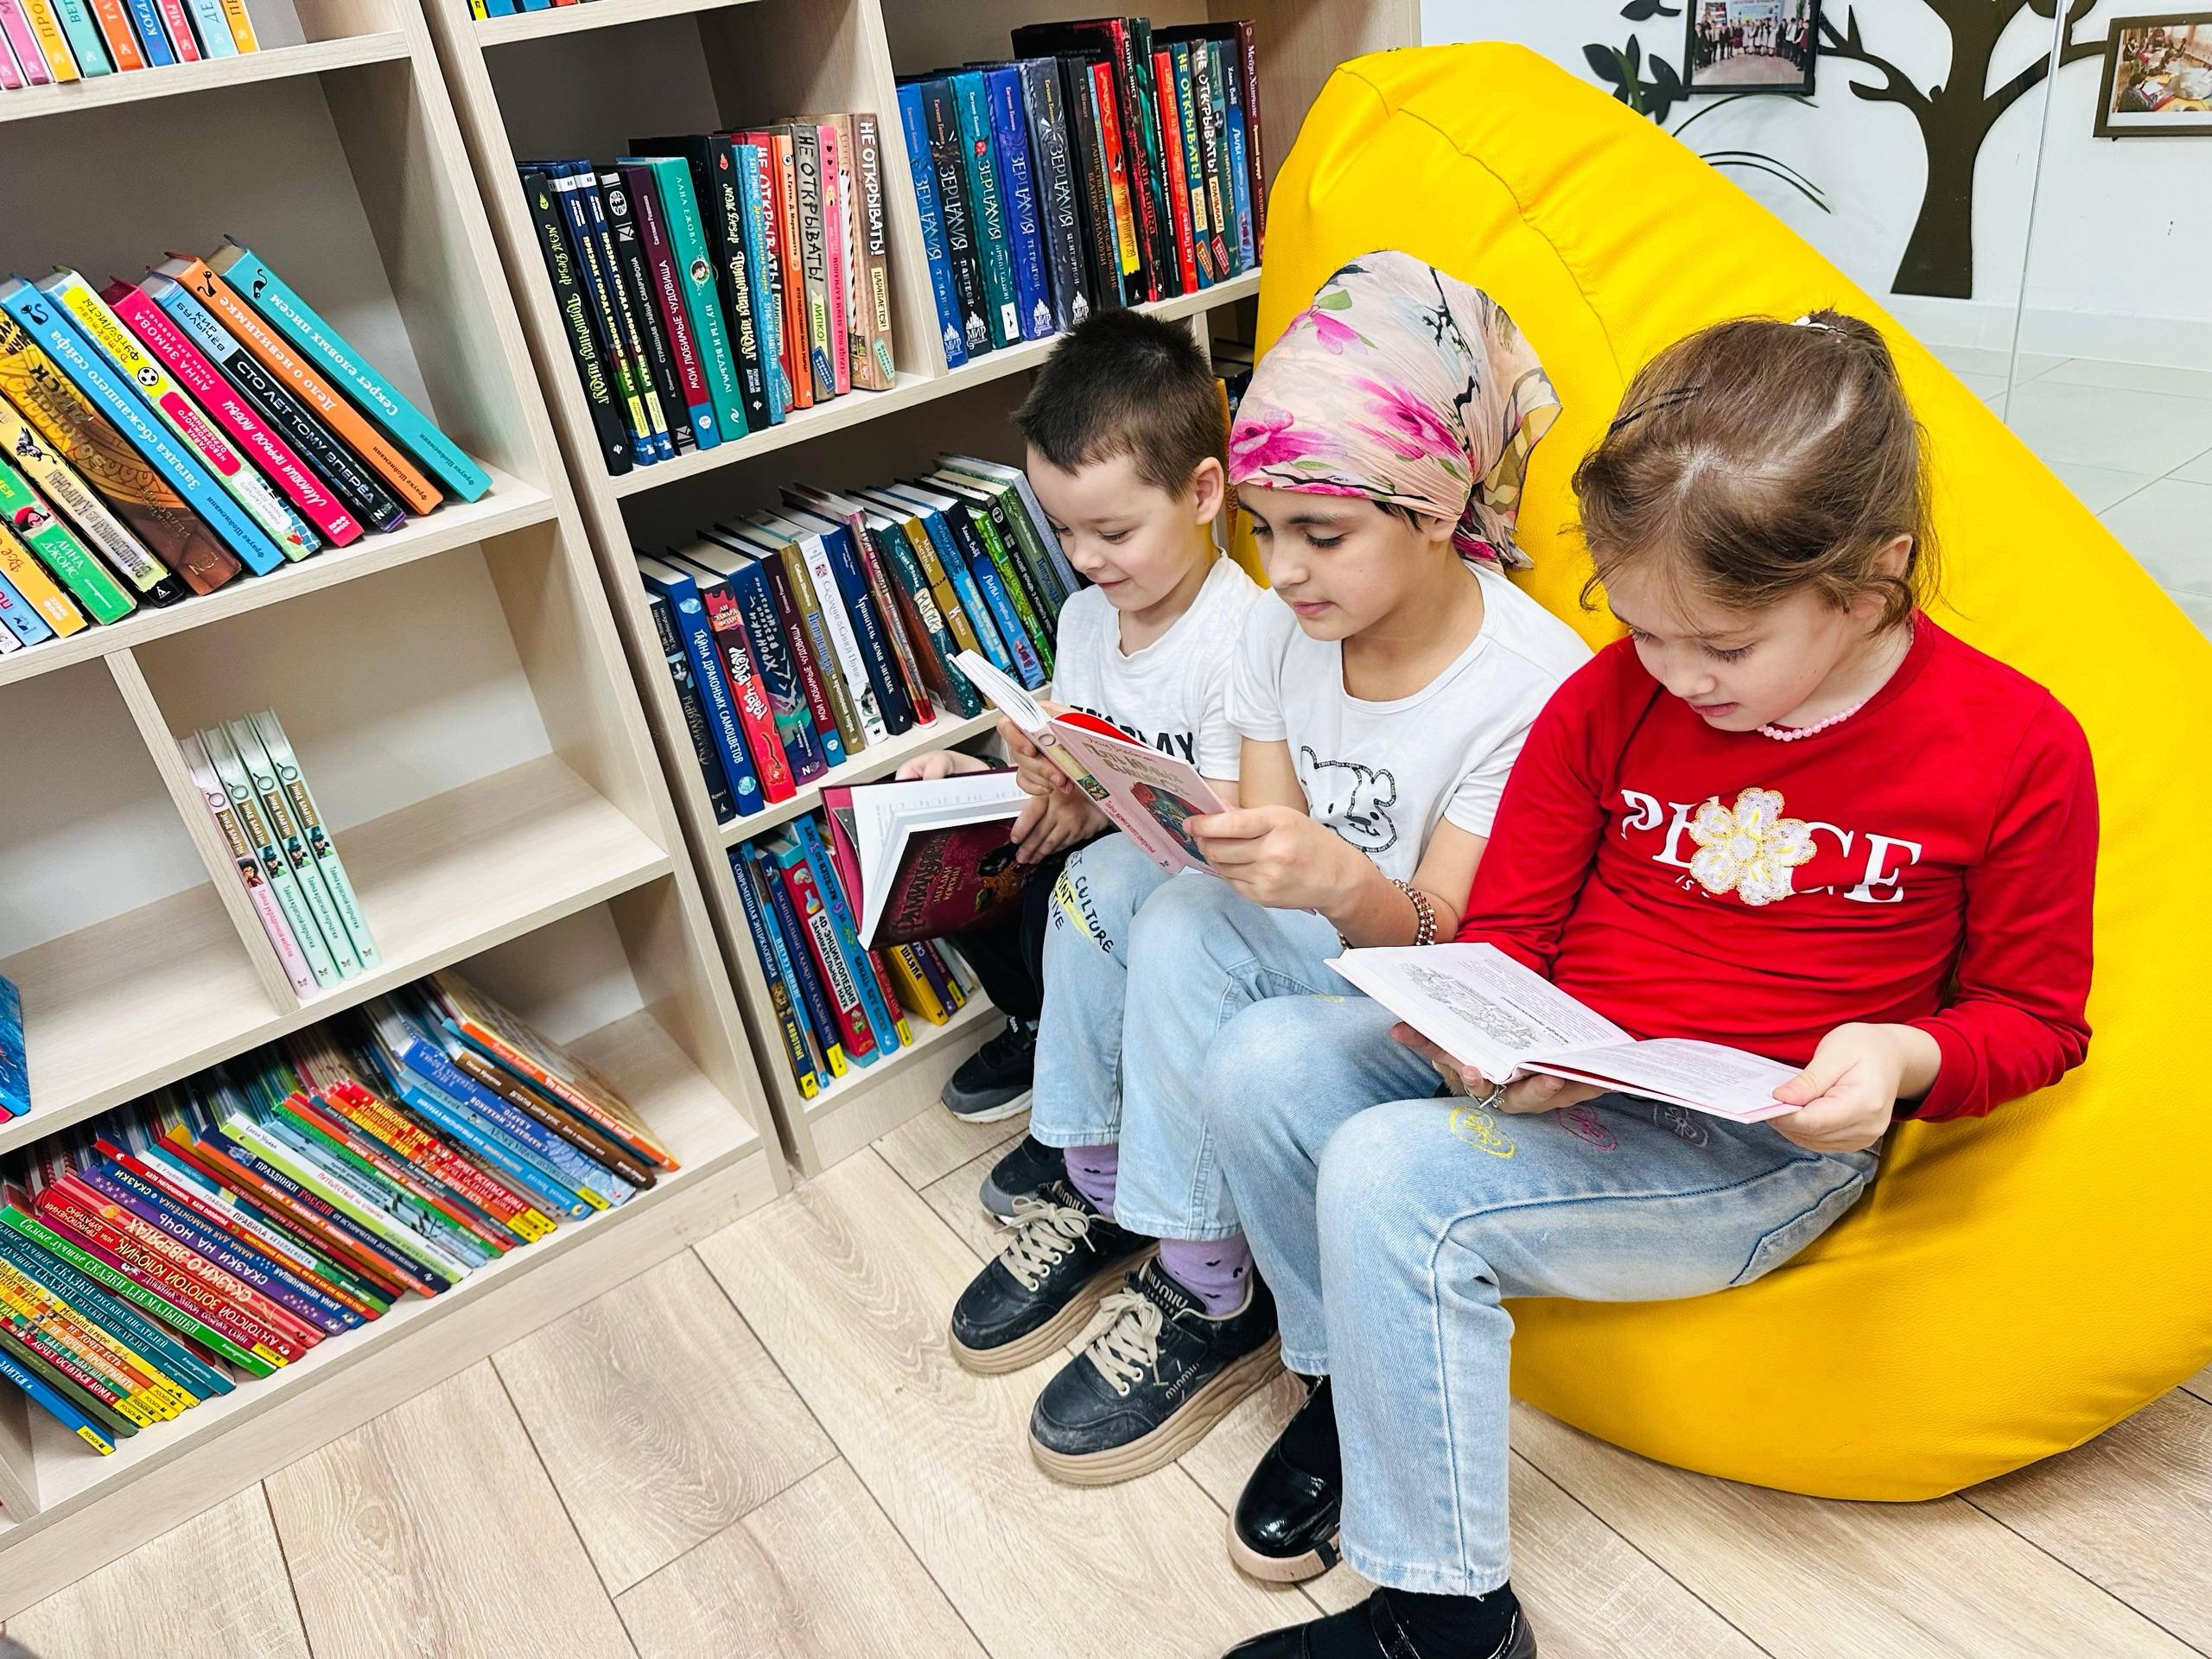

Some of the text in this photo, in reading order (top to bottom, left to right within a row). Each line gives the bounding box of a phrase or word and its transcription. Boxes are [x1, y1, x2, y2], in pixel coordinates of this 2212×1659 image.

[1246, 44, 1255, 75] Мейзи
[1178, 52, 1201, 180] НЕ ОТКРЫВАТЬ!
[1196, 48, 1217, 174] НЕ ОТКРЫВАТЬ!
[1233, 126, 1242, 154] Лили
[675, 175, 696, 245] ЛАНА ЕЖОВА
[799, 134, 821, 283] НЕ ОТКРЫВАТЬ!
[859, 121, 883, 255] НЕ ОТКРЫВАТЬ!
[938, 164, 968, 251] ЗЕРЦАЛИЯ
[975, 158, 1004, 239] ЗЕРЦАЛИЯ
[1010, 150, 1035, 234] ЗЕРЦАЛИЯ
[1047, 143, 1075, 227] ЗЕРЦАЛИЯ
[1211, 181, 1222, 229] ГОЛОДНАЯ!
[915, 174, 942, 261] ЗЕРЦАЛИЯ
[582, 235, 600, 276] ПРИЗРАК
[594, 277, 611, 315] ГОРОДА
[601, 232, 629, 309] ПРИЗРАК ГОРОДА
[658, 259, 679, 314] ЧУДОВИЩА
[874, 270, 886, 327] ЦАРАПАЕТСЯ!
[194, 311, 218, 334] КИР
[631, 256, 665, 364] СТРАШНАЯ ТАЙНА СМАРТФОНА
[673, 315, 692, 365] ЛЮБИМЫЕ
[815, 302, 823, 342] ЛИПКО!
[45, 327, 92, 376] сейфа
[131, 311, 211, 393] АННА ЗИМОВА
[216, 296, 337, 412] Дело о невидимке
[267, 292, 399, 416] Секрет еловых писем
[687, 366, 698, 390] МОИ
[705, 303, 732, 393] НУ ТЫ ВЕДЬМА!
[84, 368, 159, 446] сбежавшего
[175, 407, 228, 463] НЕВОЗМОЖНОГО
[186, 410, 228, 454] ОГРАБЛЕНИЯ
[235, 359, 377, 504] СТО ЛЕТ ТОМУ ВПЕРЁД
[152, 441, 202, 492] Загадка
[185, 428, 208, 452] ТАЙНА
[250, 429, 288, 468] первой
[280, 461, 327, 510] Мелодия
[404, 477, 429, 500] Фрауке
[43, 465, 152, 580] ВОЛШЕБНИКИ КАПРОНЫ
[240, 532, 265, 558] Фрауке
[41, 542, 79, 579] ДЖОНС
[55, 540, 85, 569] ЛИНА
[983, 573, 999, 597] Лили
[747, 610, 776, 671] ХРОНИКИ
[854, 594, 894, 694] Хранитель дома загадок
[692, 628, 743, 764] ТАЙНА ДРАКОНЬИХ САМОЦВЕТОВ
[790, 623, 828, 721] МОИ ЛЮБИМЫЕ ЧУДОВИЩА
[219, 811, 245, 855] ЭНИД БЛАЙТОН
[242, 803, 266, 845] ЭНИД БЛАЙТОН
[268, 792, 292, 836] ЭНИД БЛАЙТОН
[290, 783, 315, 826] ЭНИД БЛАЙТОН
[732, 862, 777, 977] СОВРЕМЕННАЯ ЭНЦИКЛОПЕДИЯ
[1074, 875, 1114, 954] CULTURE
[810, 919, 849, 1009] ЗАНИМАТЕЛЬНЫХ НАУК
[785, 1021, 805, 1060] ЖИВОТНЫЕ
[114, 1168, 152, 1195] СКАЗКИ
[254, 1160, 298, 1193] ПРАЗДНИКИ
[348, 1109, 483, 1205] МЫШОНОК ТИМ НЕ ХОЧЕТ ЕСТЬ
[369, 1100, 524, 1210] МЫШОНОК ТИМ ХОЧЕТ ОСТАТЬСЯ ДОМА
[44, 1201, 98, 1237] ПРИКЛЮЧЕНИЯ
[65, 1205, 103, 1232] БУРАТИНО
[156, 1211, 269, 1287] СКАЗКИ НА НОЧЬ
[157, 1196, 255, 1260] МАМА ДЛЯ МАМОНТЁНКА
[232, 1211, 268, 1237] ПРАВИЛА
[18, 1214, 200, 1335] Самые лучшие СКАЗКИ ДЛЯ МАЛЫШЕЙ
[124, 1217, 253, 1303] СКАЗКИ О ЗВЕРЯТАХ
[164, 1269, 221, 1312] ЗОЛОТОЙ
[18, 1240, 168, 1349] лучшие СКАЗКИ РУССКИХ ПИСАТЕЛЕЙ
[34, 1266, 150, 1354] СКАЗКИ РУССКИХ ПИСАТЕЛЕЙ
[319, 1294, 341, 1312] ДИНА
[31, 1338, 110, 1400] ХОЧЕТ ОСТАТЬСЯ ДОМА
[44, 1335, 106, 1382] ЕДЕТ БАБУШКЕ
[48, 1325, 135, 1389] НЕ ХОЧЕТ ПРОИГРЫВАТЬ
[66, 1323, 122, 1367] НЕ ХОЧЕТ ЕСТЬ
